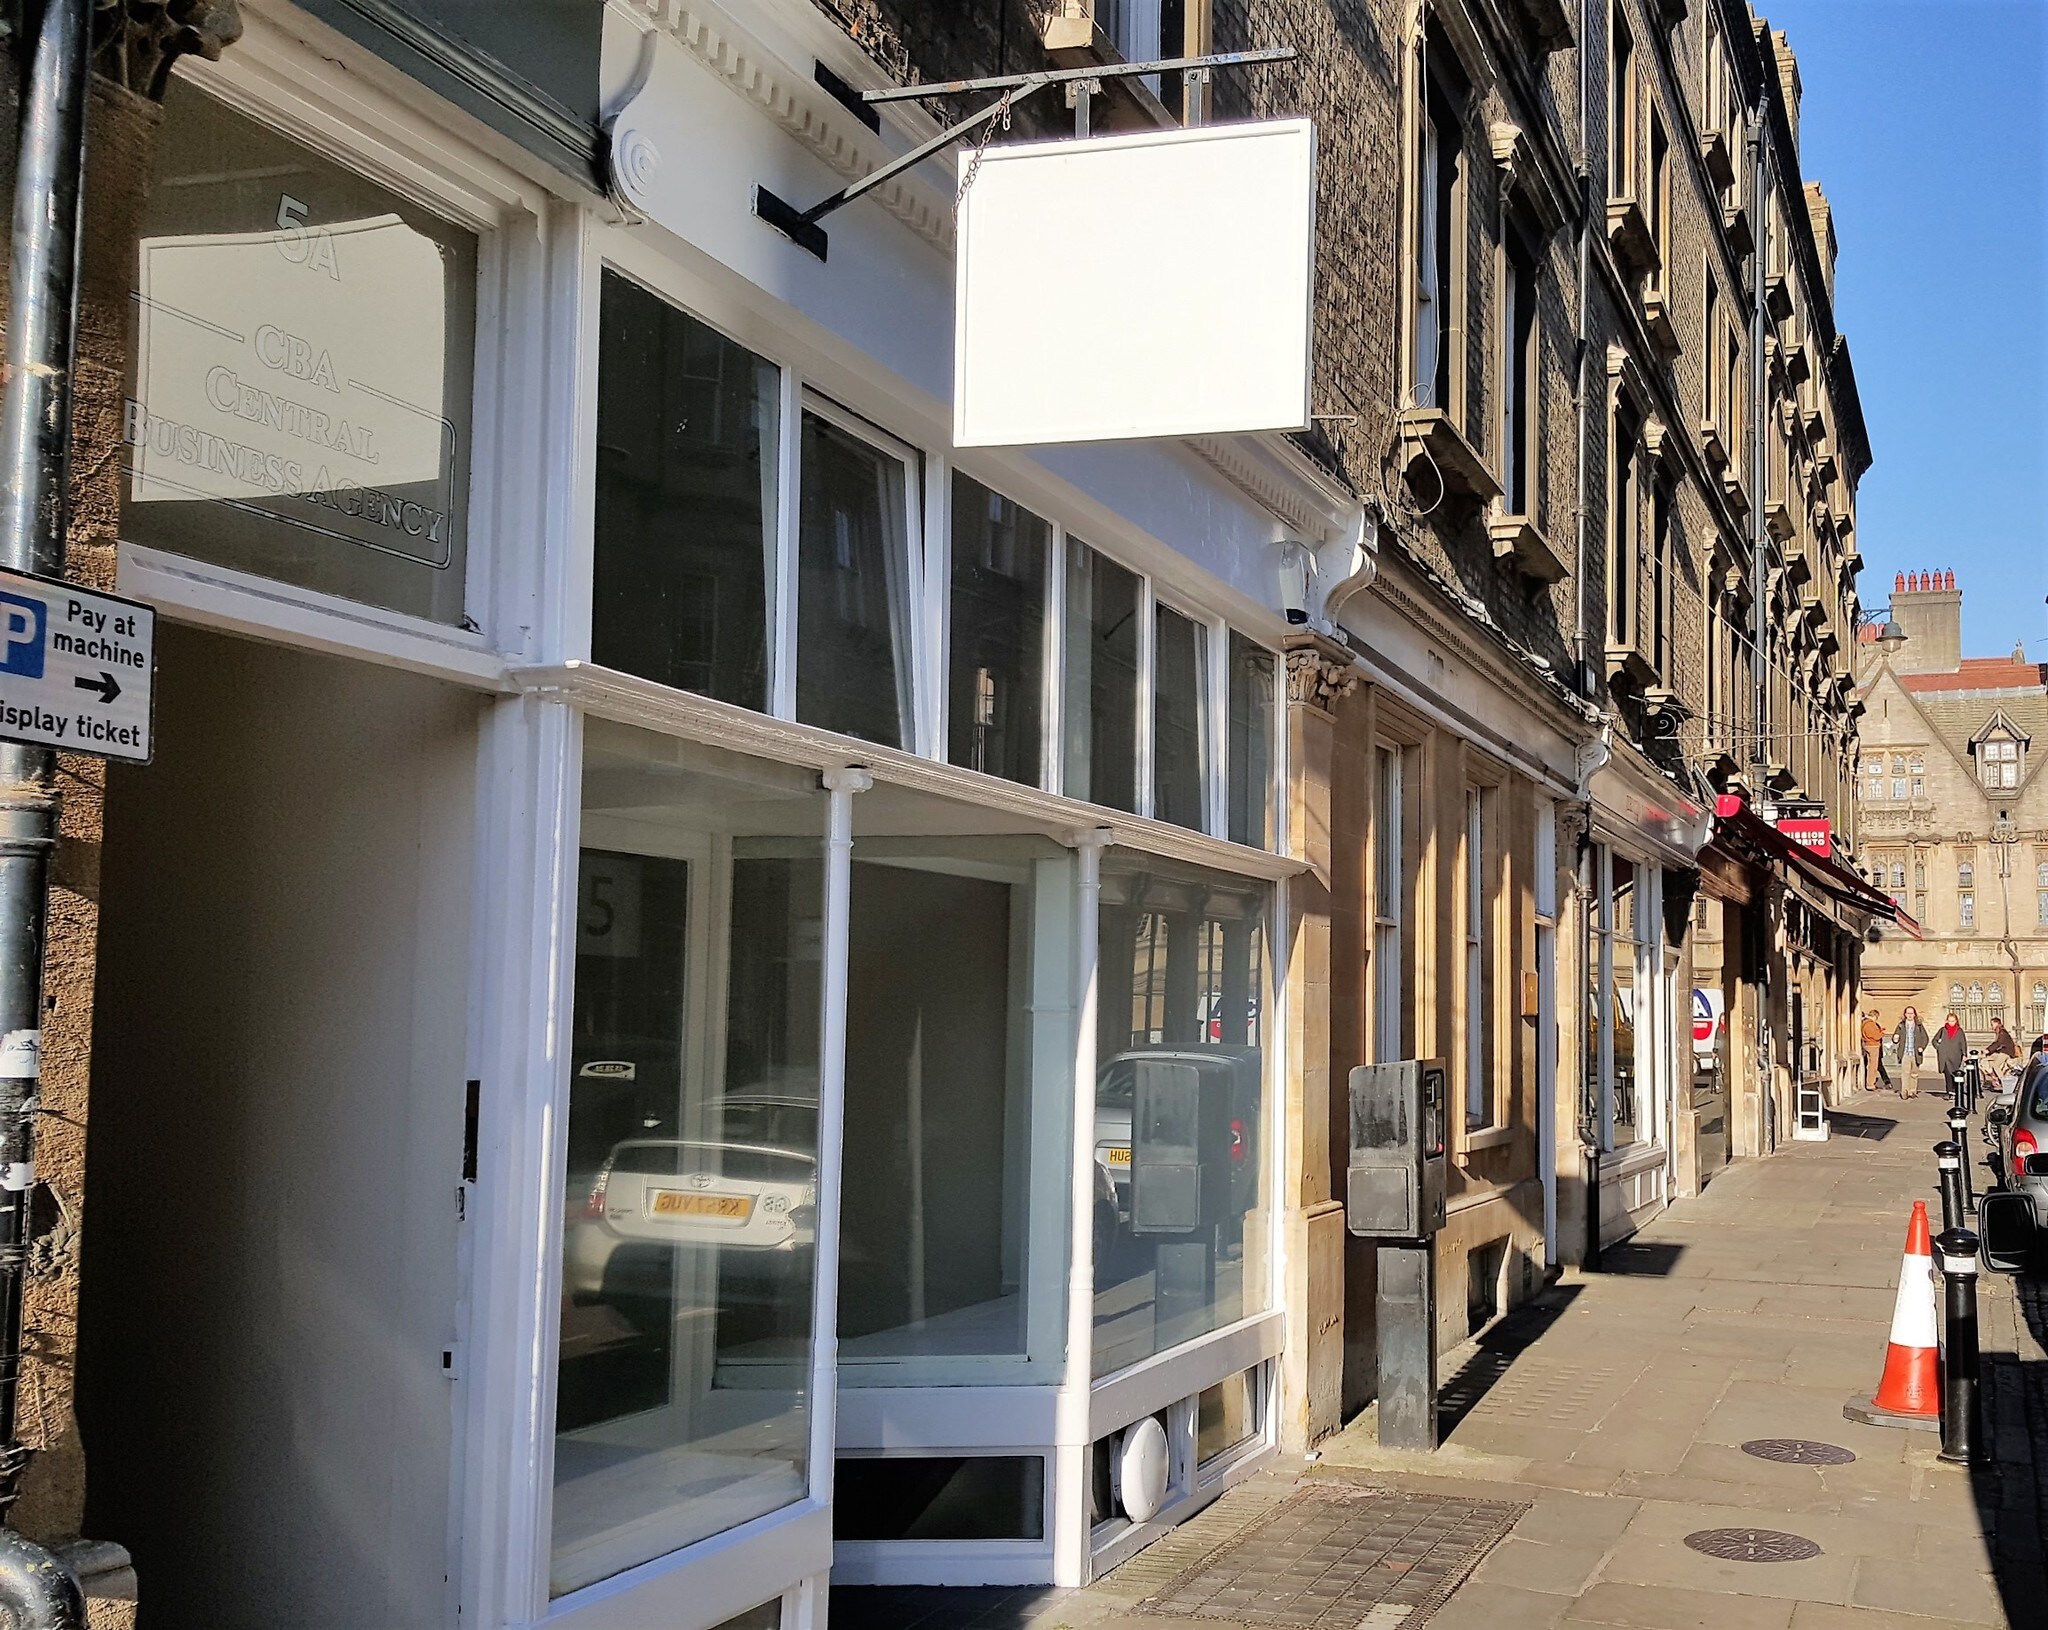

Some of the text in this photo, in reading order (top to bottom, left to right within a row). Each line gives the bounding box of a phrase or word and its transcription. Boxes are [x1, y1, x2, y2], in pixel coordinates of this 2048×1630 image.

[272, 192, 341, 281] 5A
[254, 323, 341, 393] CBA
[205, 365, 380, 464] CENTRAL
[123, 399, 443, 542] BUSINESS AGENCY
[53, 632, 145, 669] machine
[67, 599, 135, 637] Pay at
[76, 714, 141, 748] ticket
[586, 876, 613, 936] 5
